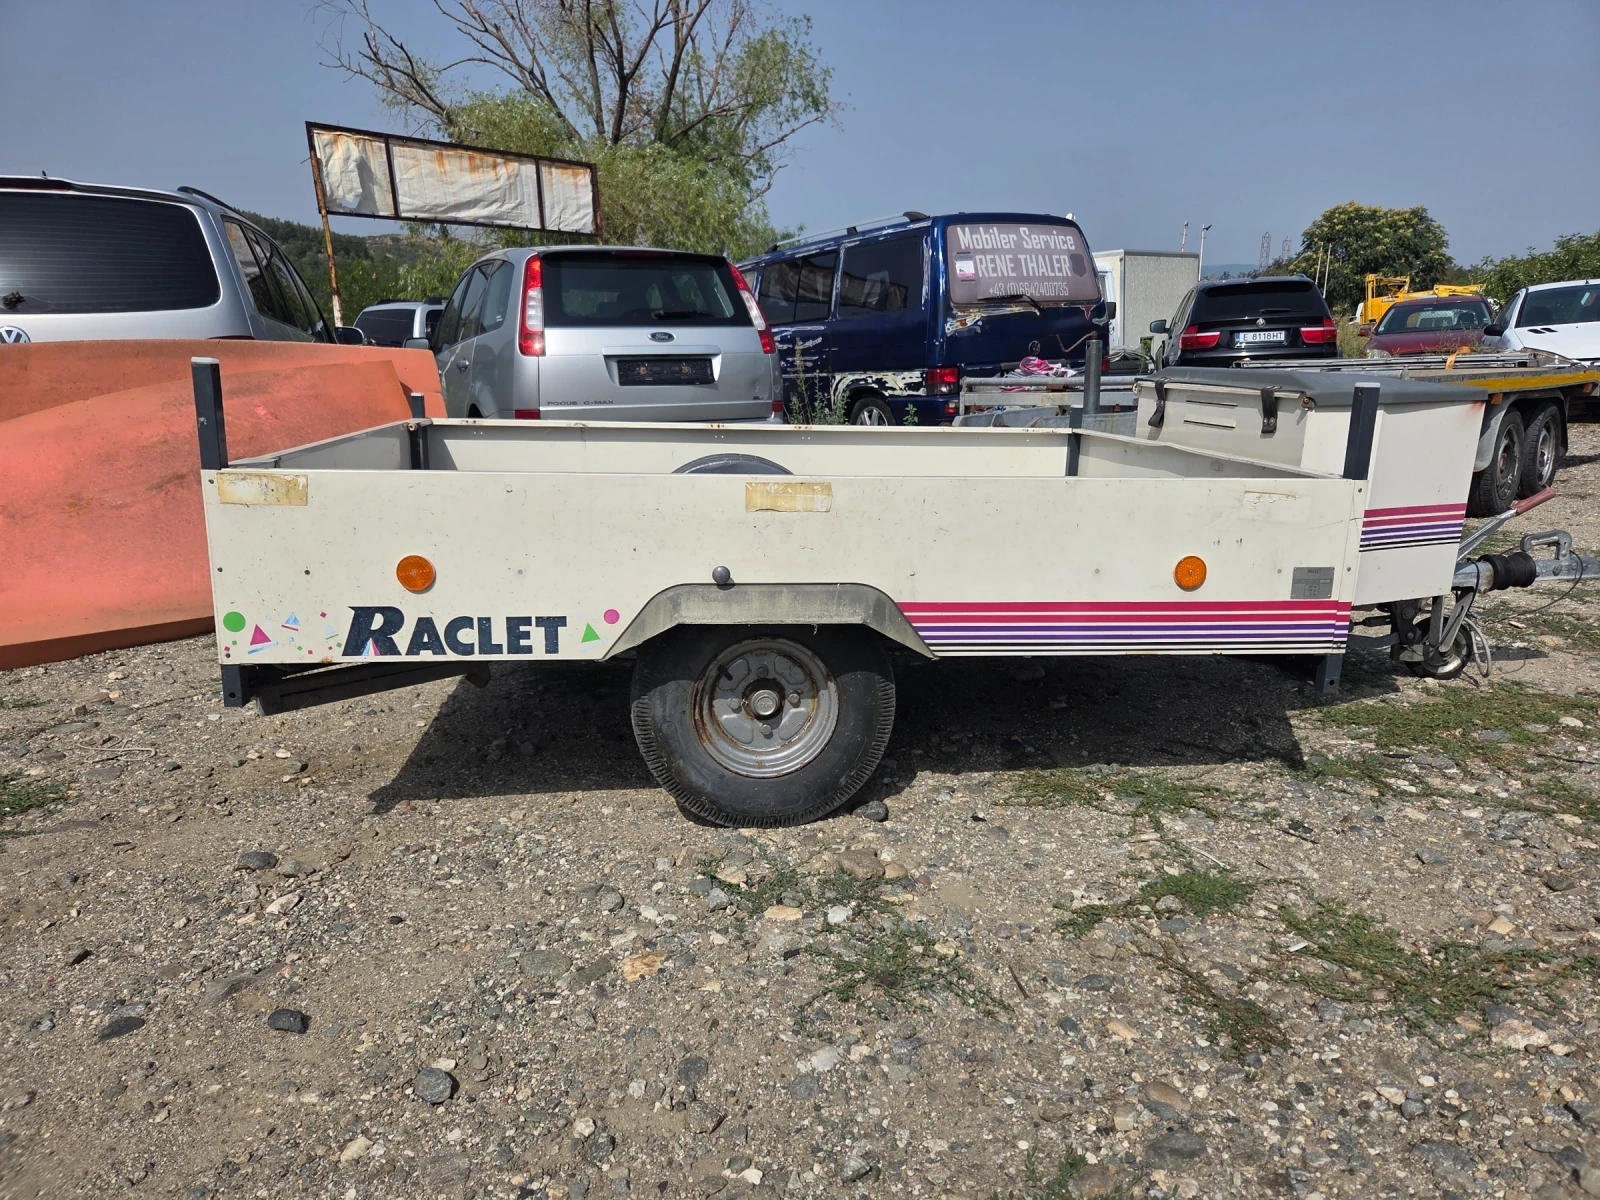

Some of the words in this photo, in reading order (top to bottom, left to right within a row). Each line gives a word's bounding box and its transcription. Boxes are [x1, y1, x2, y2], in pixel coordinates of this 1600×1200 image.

[957, 227, 1017, 250] Mobiler
[1019, 227, 1075, 250] Service
[976, 255, 1017, 278] RENE
[1018, 255, 1072, 277] THALER
[342, 606, 567, 656] RACLET
